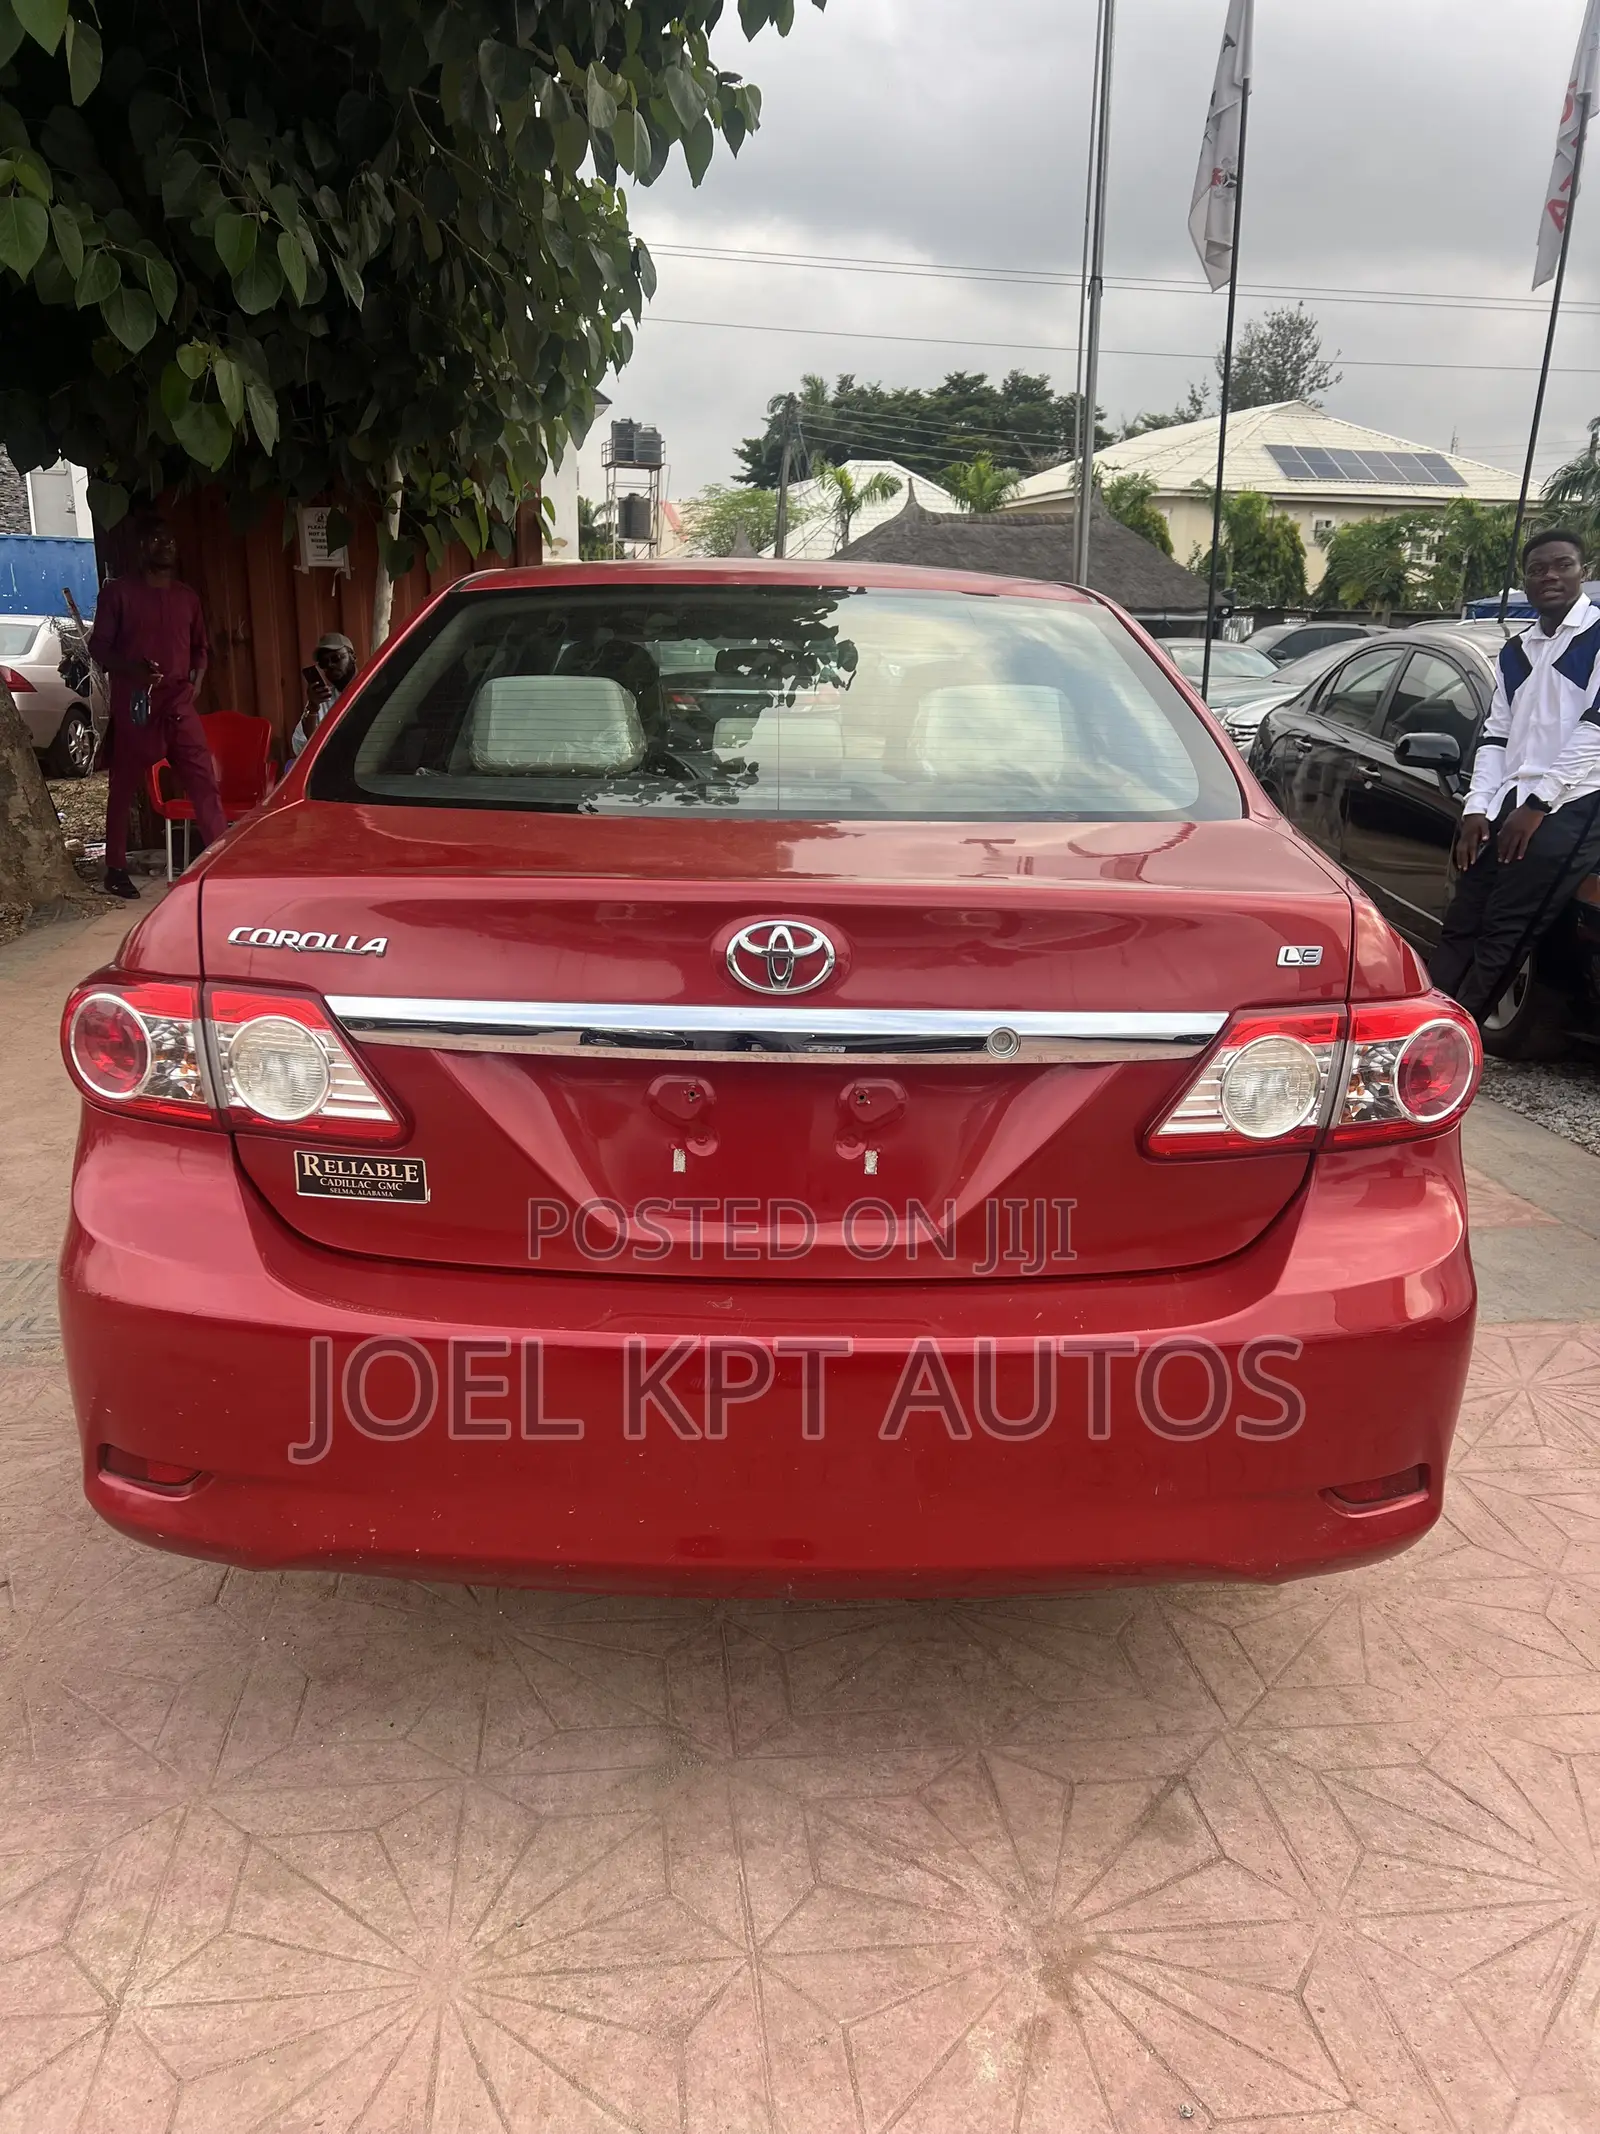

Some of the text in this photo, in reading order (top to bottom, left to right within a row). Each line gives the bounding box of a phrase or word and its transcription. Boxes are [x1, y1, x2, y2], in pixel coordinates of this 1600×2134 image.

[227, 926, 388, 957] COROLLA
[1283, 947, 1320, 964] LE
[301, 1153, 419, 1183] RELIABLE
[320, 1177, 403, 1191] CADILLAC GMC
[357, 1189, 394, 1198] ALABAMA
